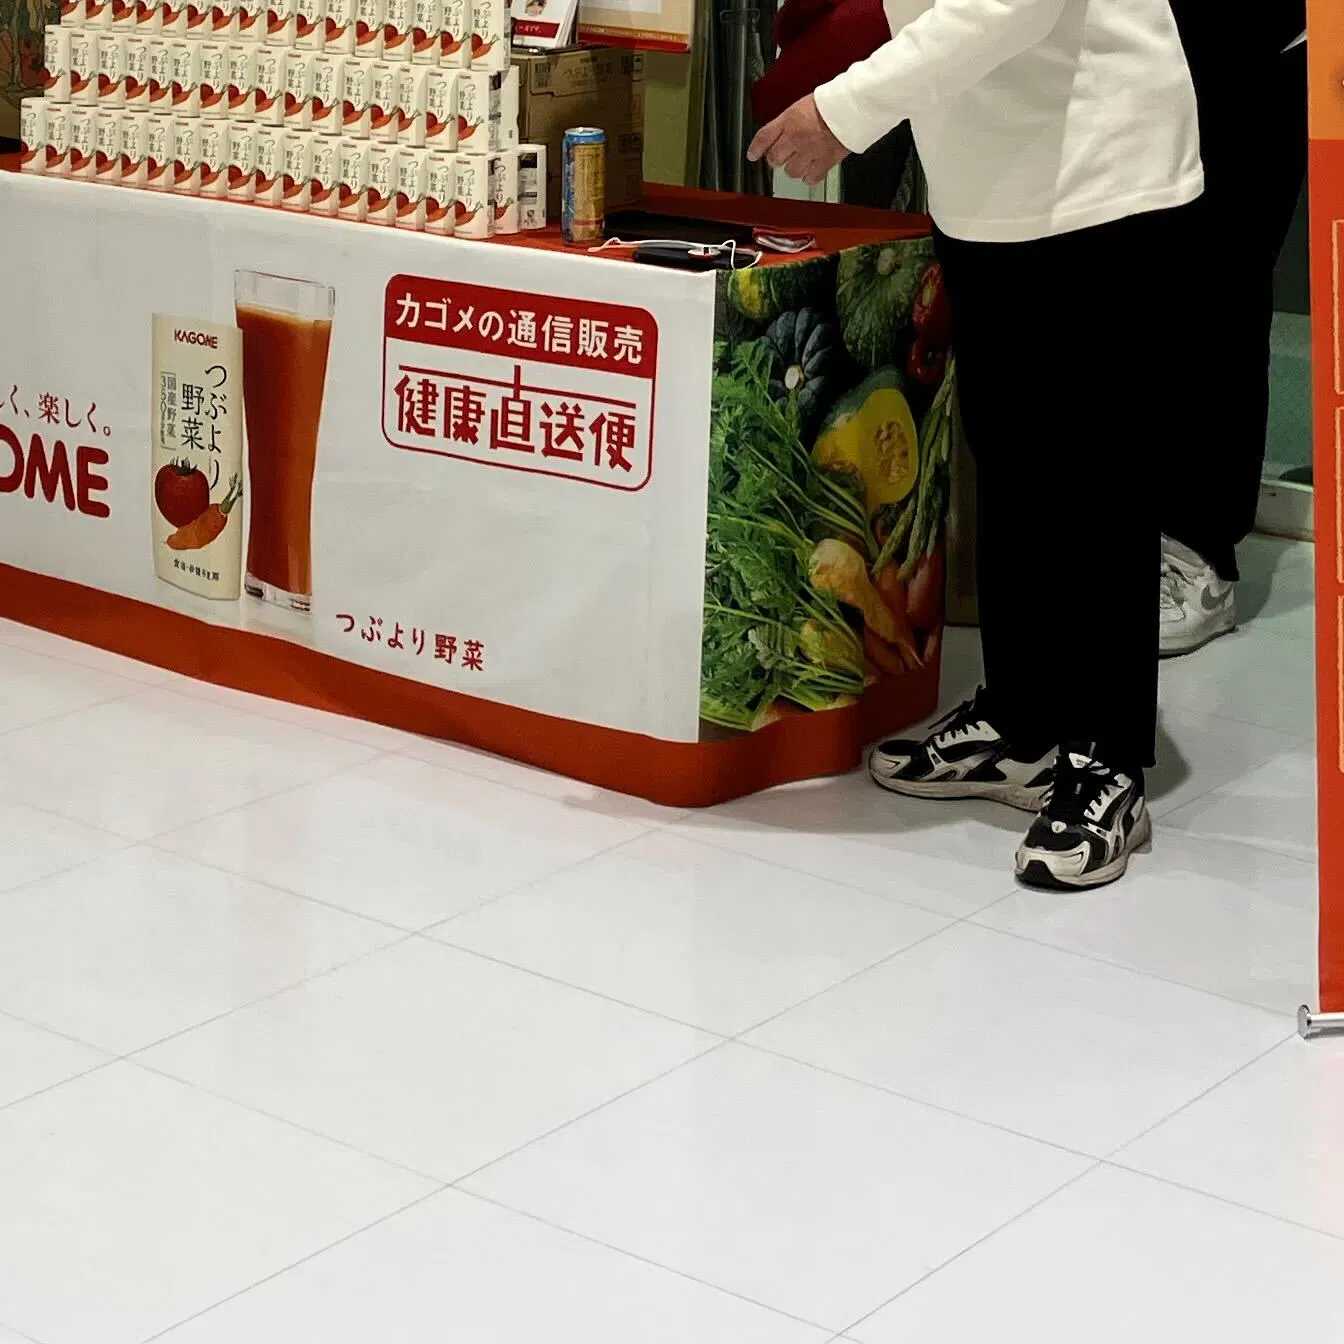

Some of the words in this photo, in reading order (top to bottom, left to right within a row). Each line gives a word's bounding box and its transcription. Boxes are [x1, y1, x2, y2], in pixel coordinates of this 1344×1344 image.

[396, 292, 644, 364] カゴメの通信販売
[181, 383, 205, 451] 野菜
[204, 365, 227, 490] つぶより
[394, 366, 637, 473] 健康直送便
[336, 613, 485, 672] つぶより野菜
